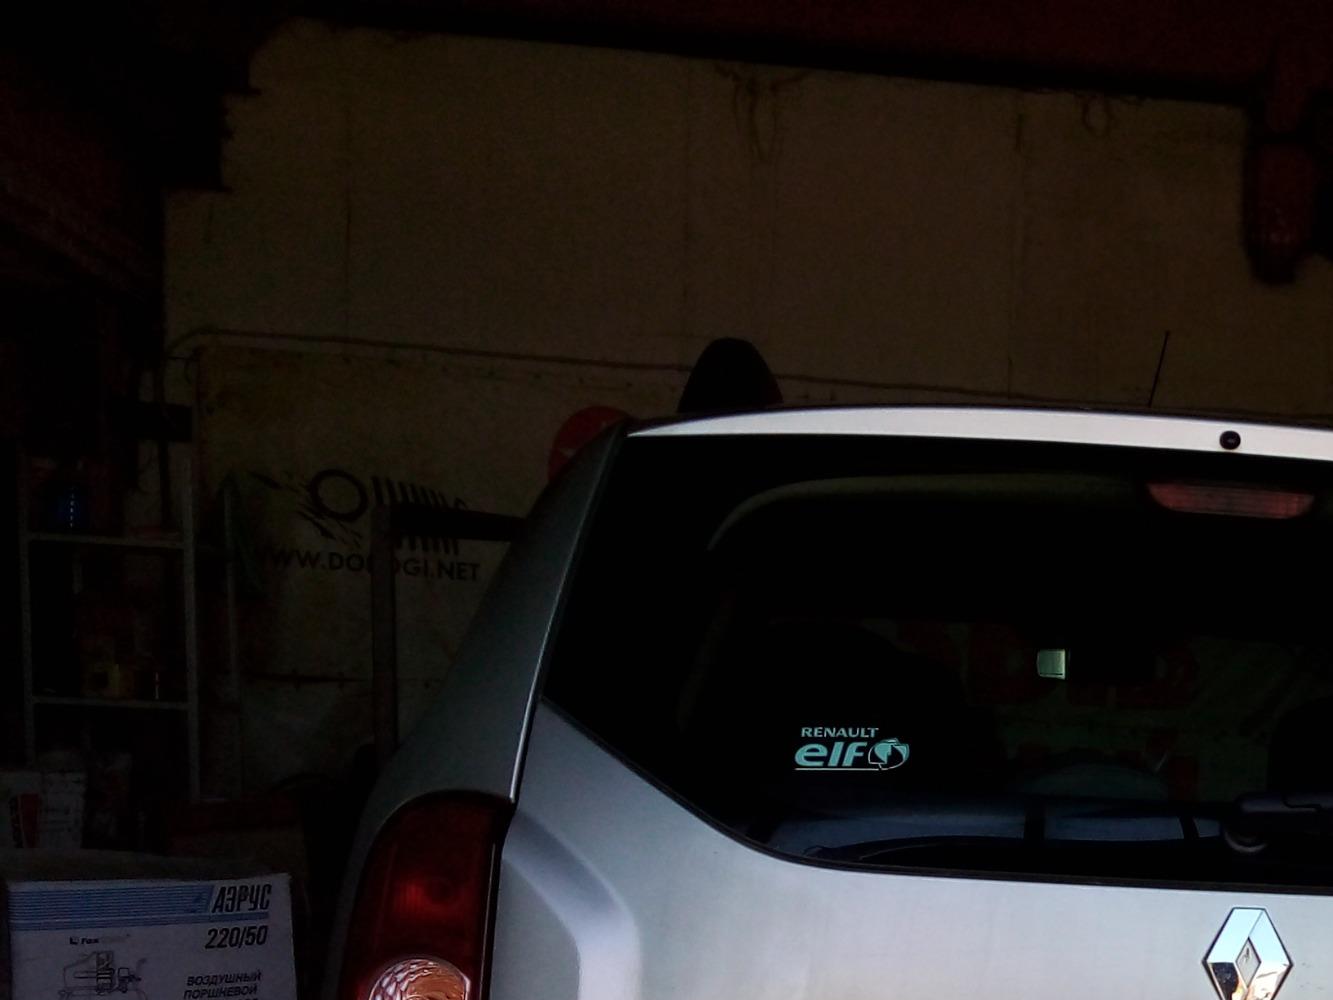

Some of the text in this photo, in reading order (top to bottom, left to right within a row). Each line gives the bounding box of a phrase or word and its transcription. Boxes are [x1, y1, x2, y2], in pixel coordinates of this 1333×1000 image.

[252, 548, 480, 580] WW.DOGI.NET
[800, 727, 879, 738] RENAULT
[794, 741, 868, 767] elf
[212, 884, 272, 913] АЭРУС
[205, 925, 268, 949] 220/50
[187, 968, 261, 986] ВОЗДУШНЫЙ
[183, 984, 258, 1000] ПОРШНЕВОЙ
